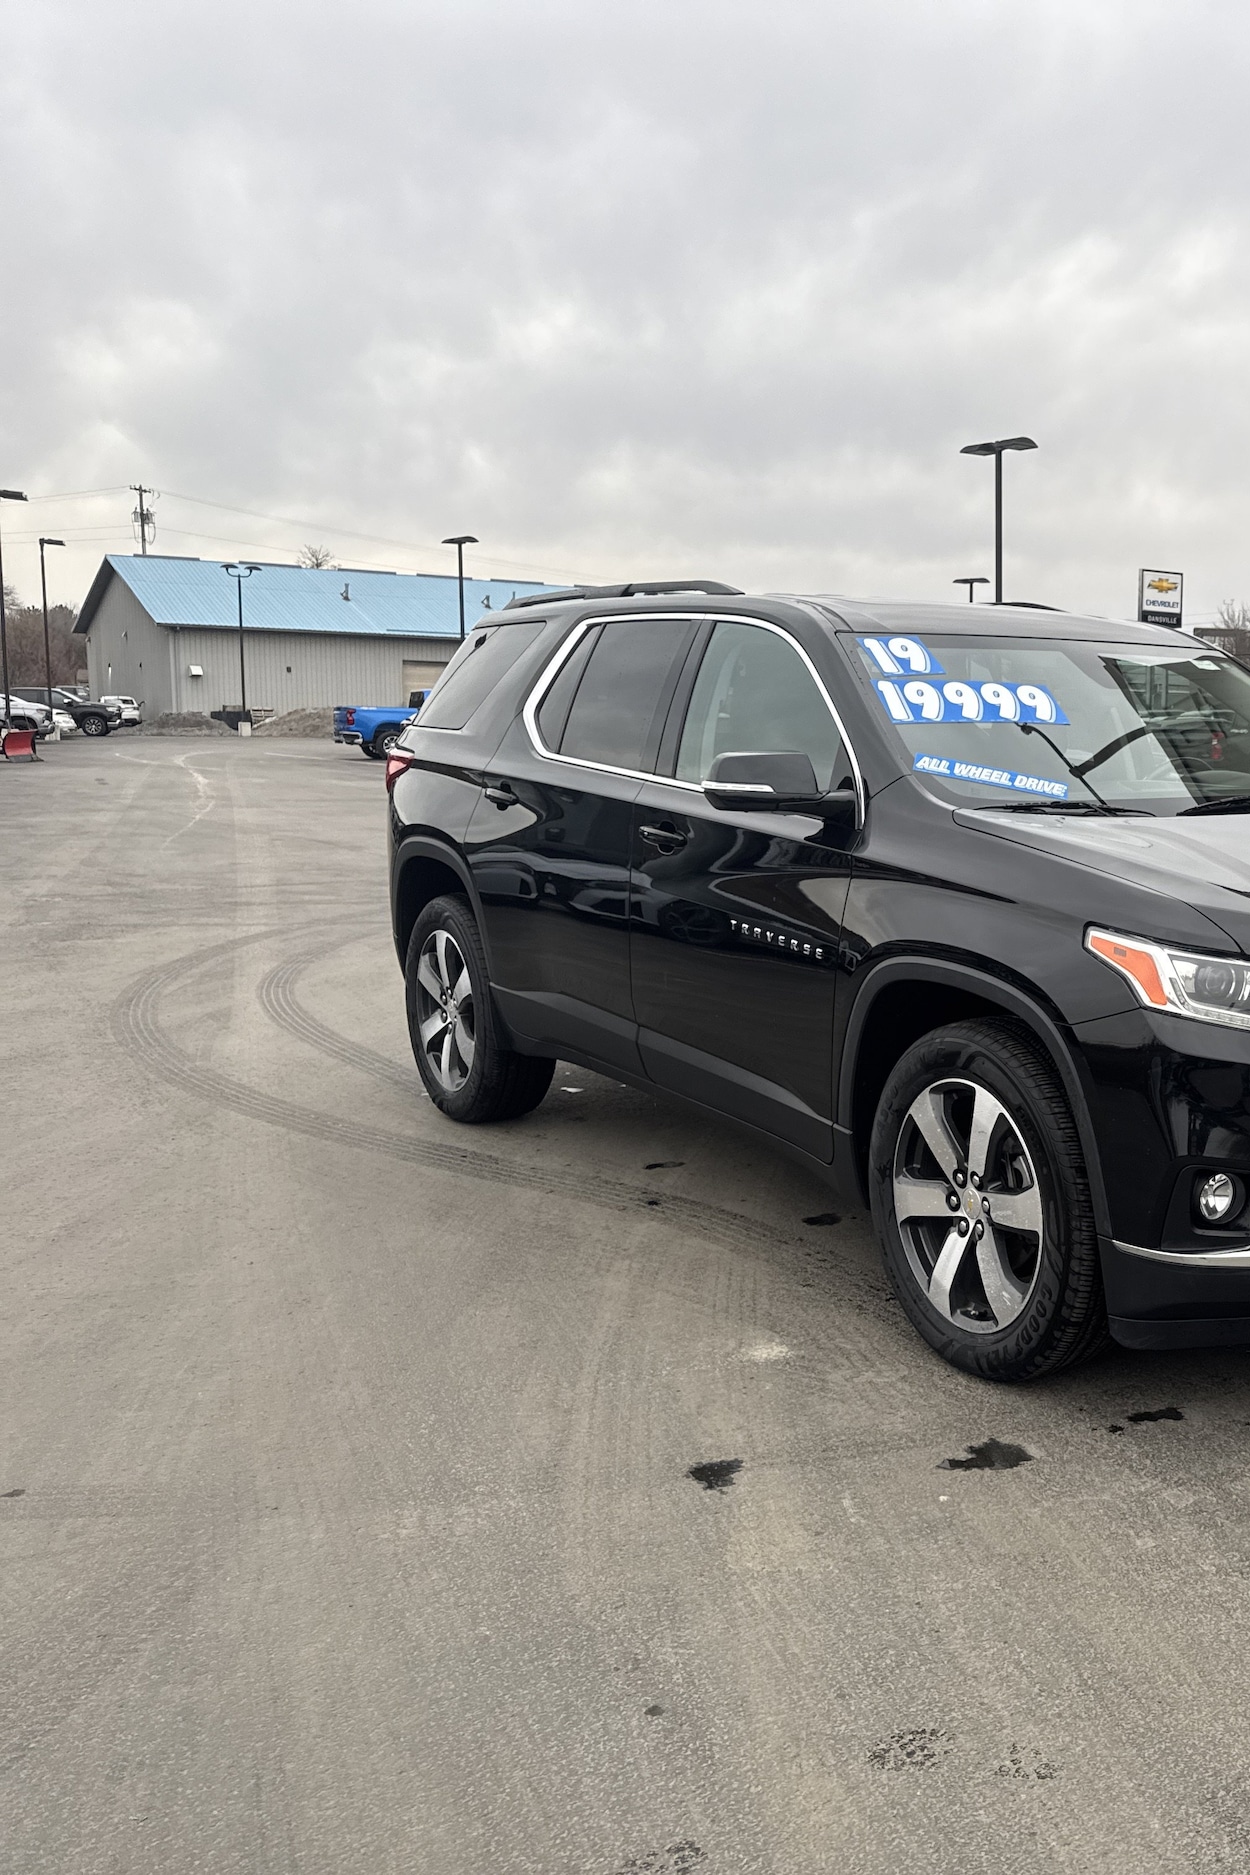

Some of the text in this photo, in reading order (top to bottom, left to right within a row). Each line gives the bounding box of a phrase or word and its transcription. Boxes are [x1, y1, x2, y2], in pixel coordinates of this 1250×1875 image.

[1145, 599, 1179, 608] CHEVROLET
[1147, 615, 1177, 624] DANSVILLE
[863, 637, 932, 674] 19
[877, 680, 1057, 723] 19999
[915, 756, 1068, 797] ALL WHEEL DRIVE
[730, 919, 823, 960] TRAVERSE
